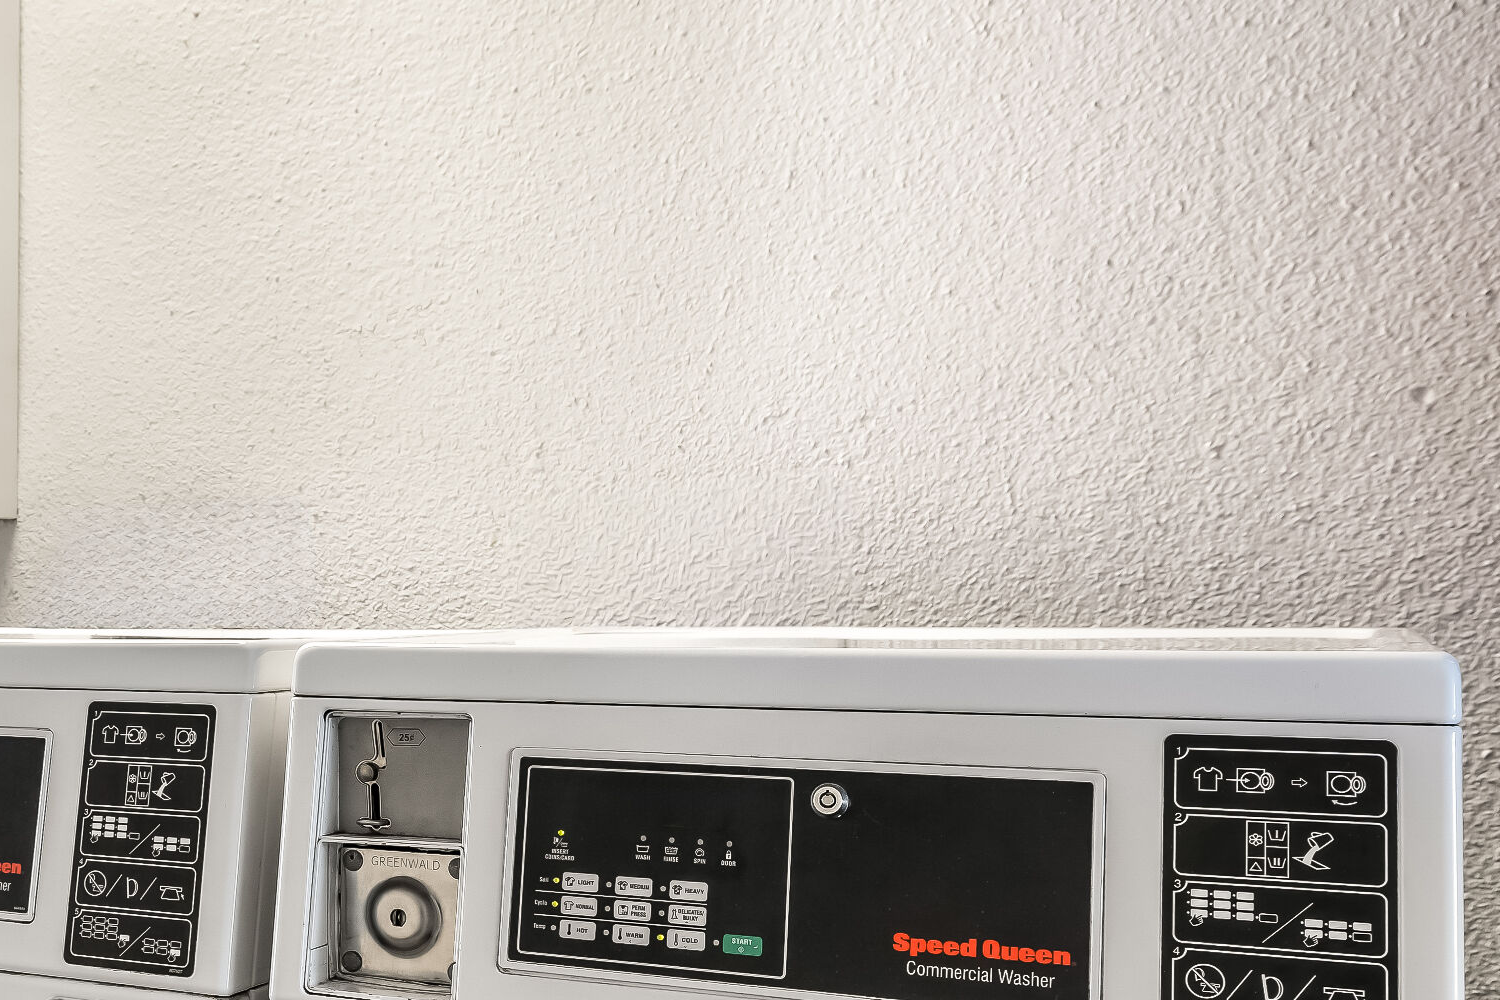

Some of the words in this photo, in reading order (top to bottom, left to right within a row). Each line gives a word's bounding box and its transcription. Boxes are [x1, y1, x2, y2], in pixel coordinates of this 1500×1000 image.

[398, 733, 415, 742] 25¢
[1175, 813, 1182, 821] 2
[371, 855, 441, 871] GREENWALD
[1174, 880, 1181, 888] 3
[731, 938, 752, 946] START
[892, 932, 978, 957] Speed
[982, 939, 1071, 966] Queen
[1173, 947, 1180, 955] 4
[906, 960, 993, 983] Commercial
[998, 968, 1056, 989] Washer
